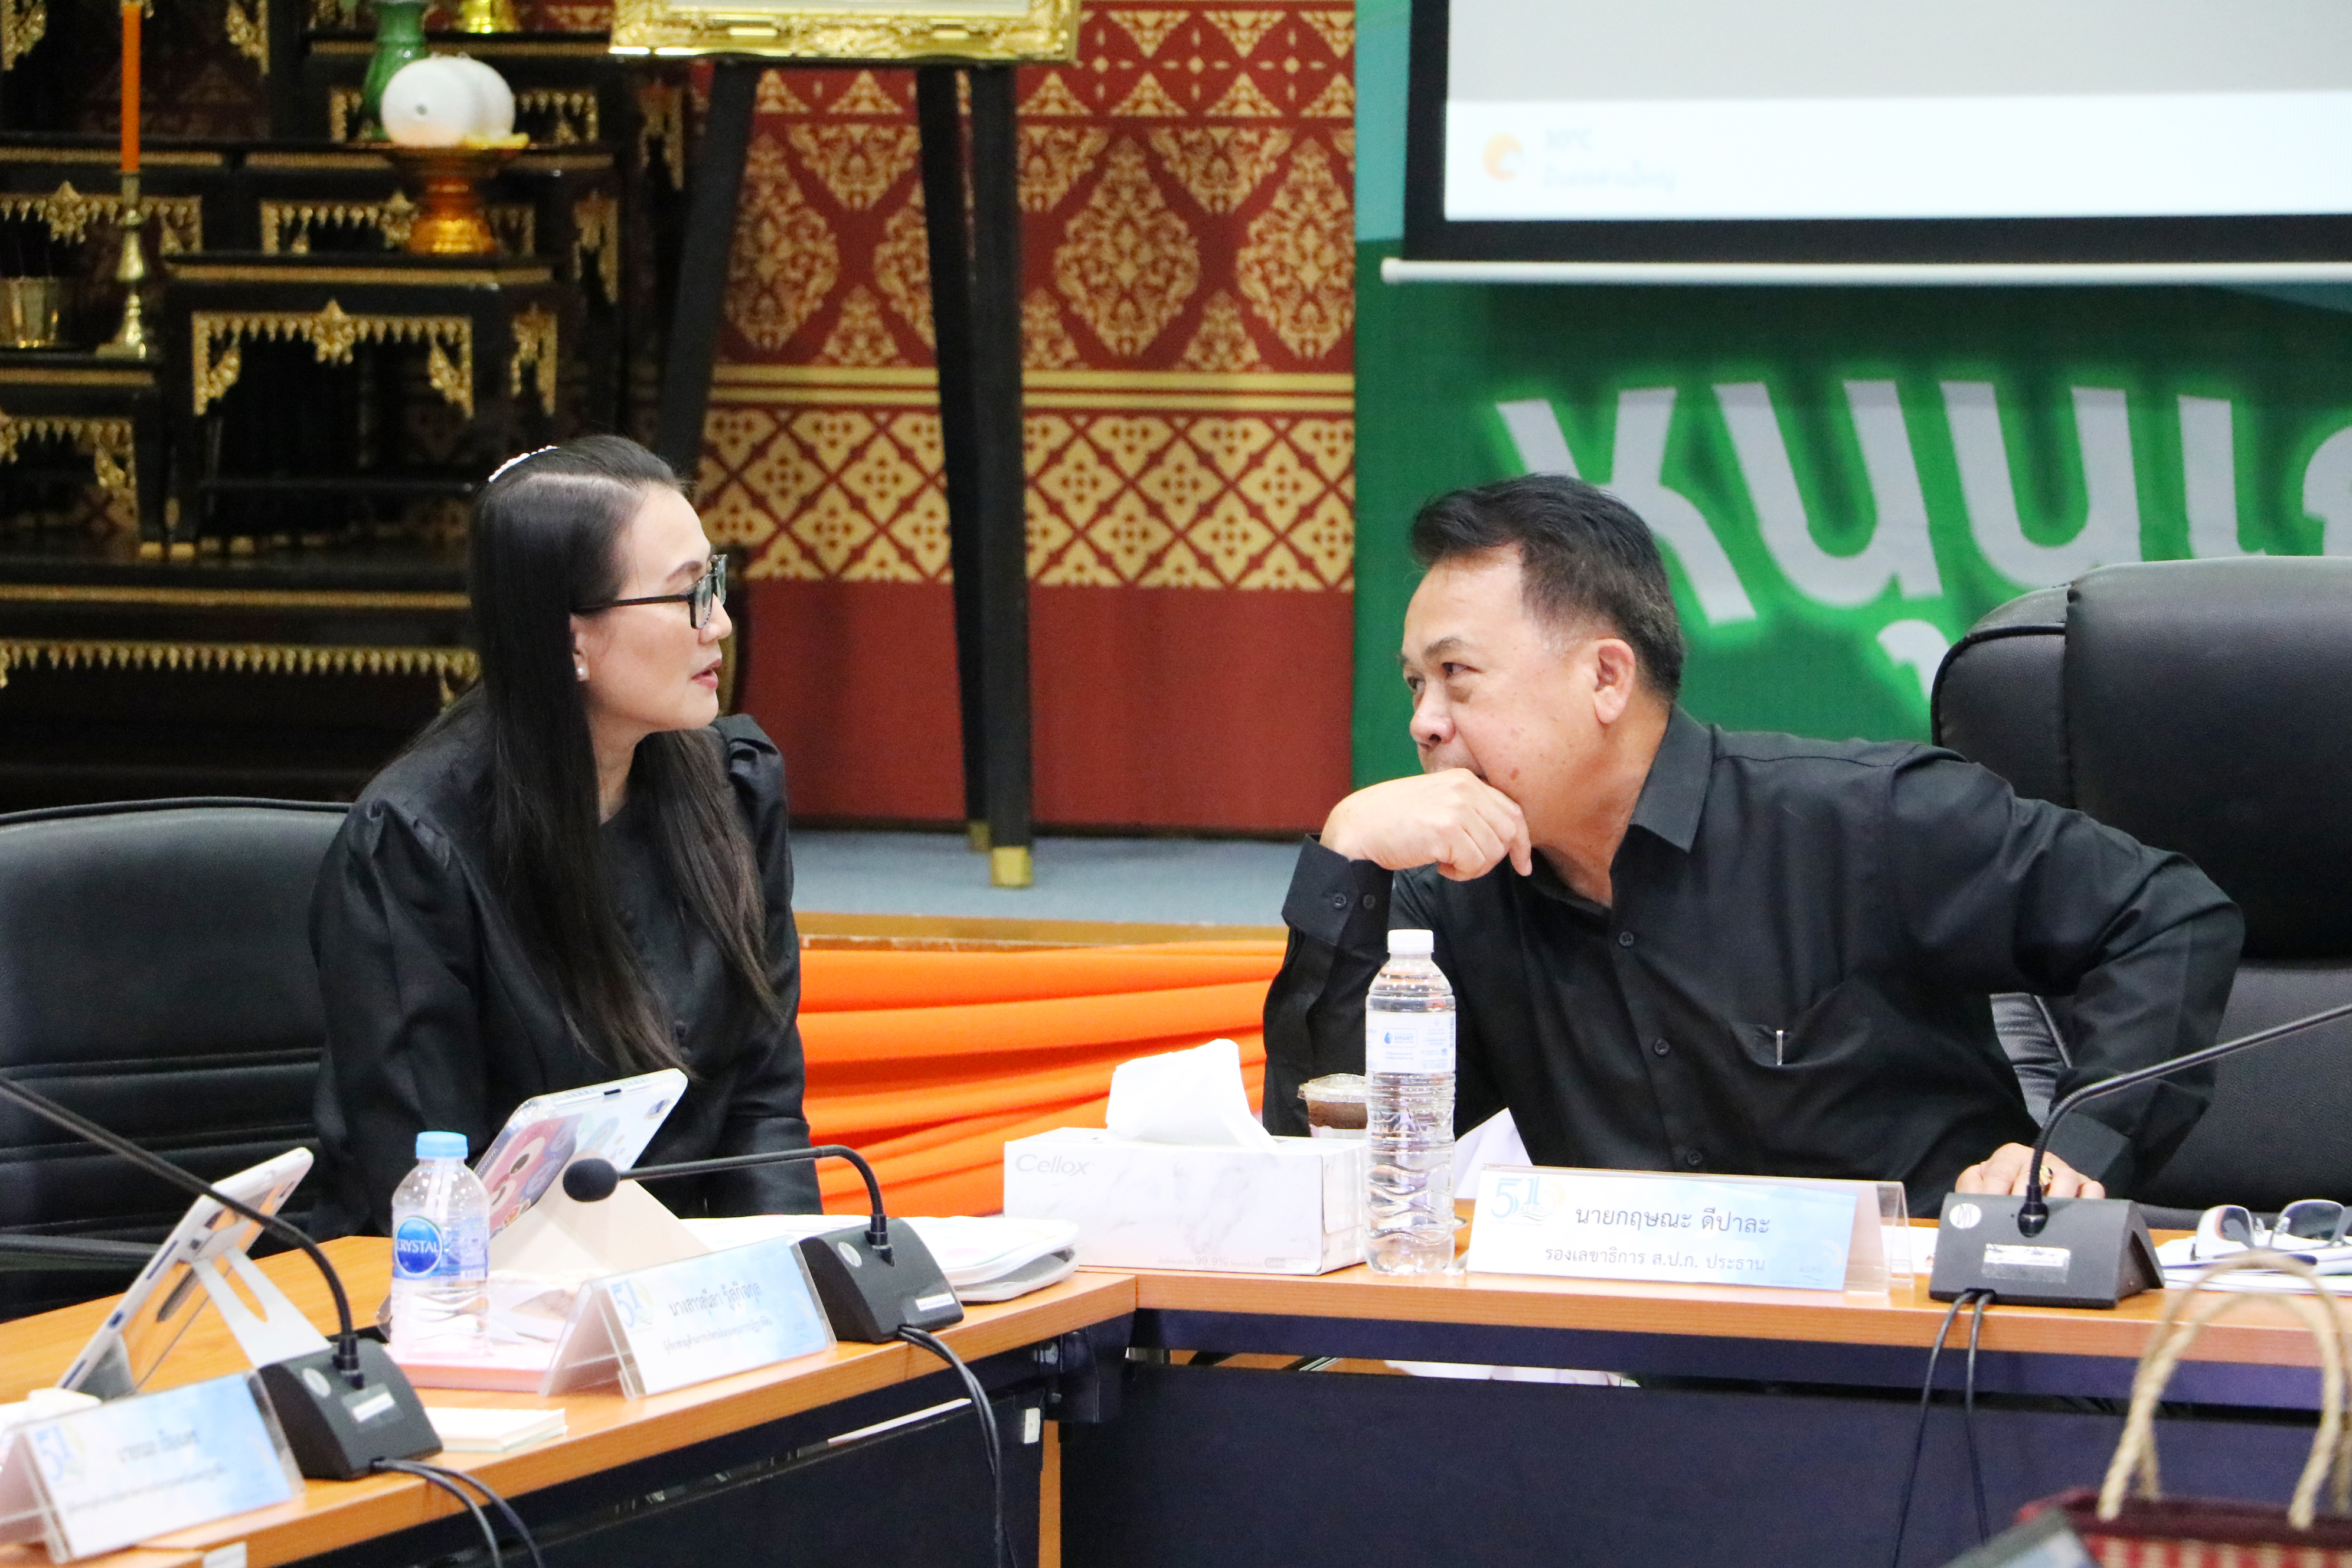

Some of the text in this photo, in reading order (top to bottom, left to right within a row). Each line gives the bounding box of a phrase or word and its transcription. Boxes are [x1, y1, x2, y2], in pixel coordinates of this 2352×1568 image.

[1495, 378, 2352, 703] หนุนเ
[1015, 1153, 1091, 1177] Cellox
[1490, 1176, 1541, 1219] 51
[1575, 1207, 1770, 1234] นายกฤษณะ ดีปาละ
[397, 1239, 440, 1253] CRYSTAL
[1545, 1246, 1766, 1272] รองเลขาธิการ ส.ป.ก. ประธาน
[1195, 1256, 1229, 1267] 99.9%
[610, 1278, 643, 1328] 51
